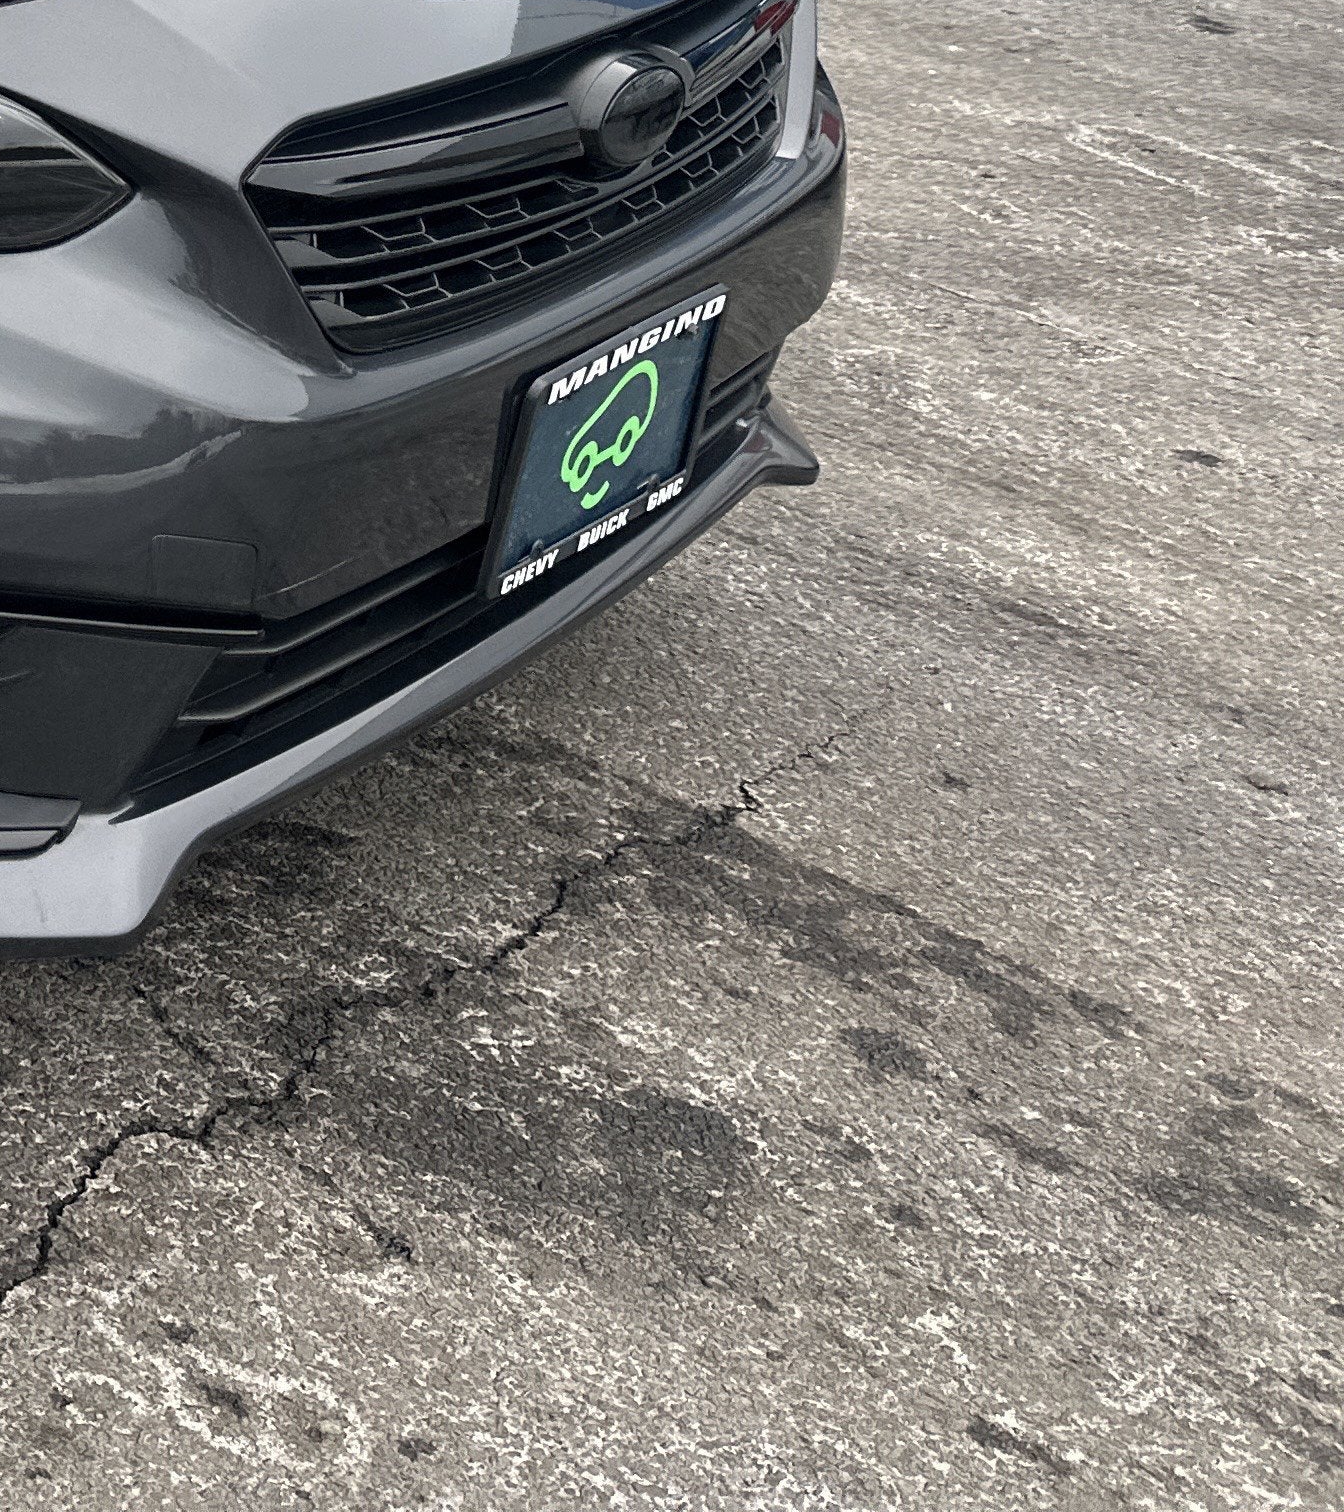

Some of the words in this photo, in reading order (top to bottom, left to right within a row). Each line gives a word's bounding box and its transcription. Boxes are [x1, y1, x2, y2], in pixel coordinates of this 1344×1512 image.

[548, 294, 726, 405] MANGINO
[500, 549, 559, 595] CHEVY
[576, 509, 630, 552] BUICK
[646, 477, 684, 512] GMC
